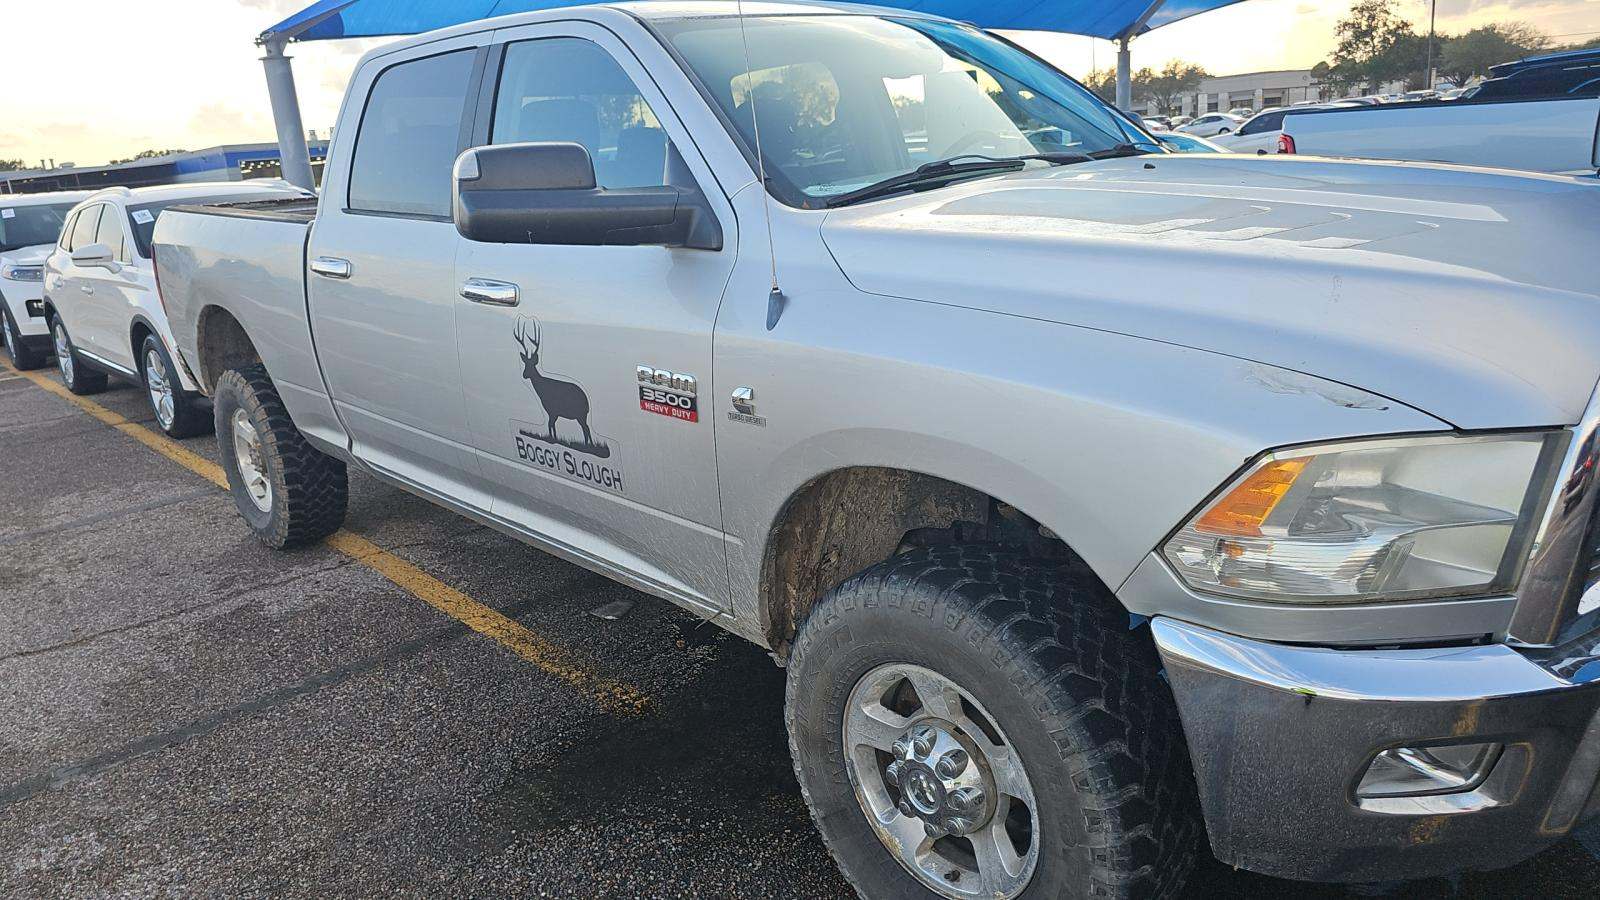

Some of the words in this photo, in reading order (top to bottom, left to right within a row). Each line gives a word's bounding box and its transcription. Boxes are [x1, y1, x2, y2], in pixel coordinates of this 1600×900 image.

[642, 387, 692, 409] 3500
[644, 402, 669, 415] HEAVY
[671, 408, 691, 420] DUTY
